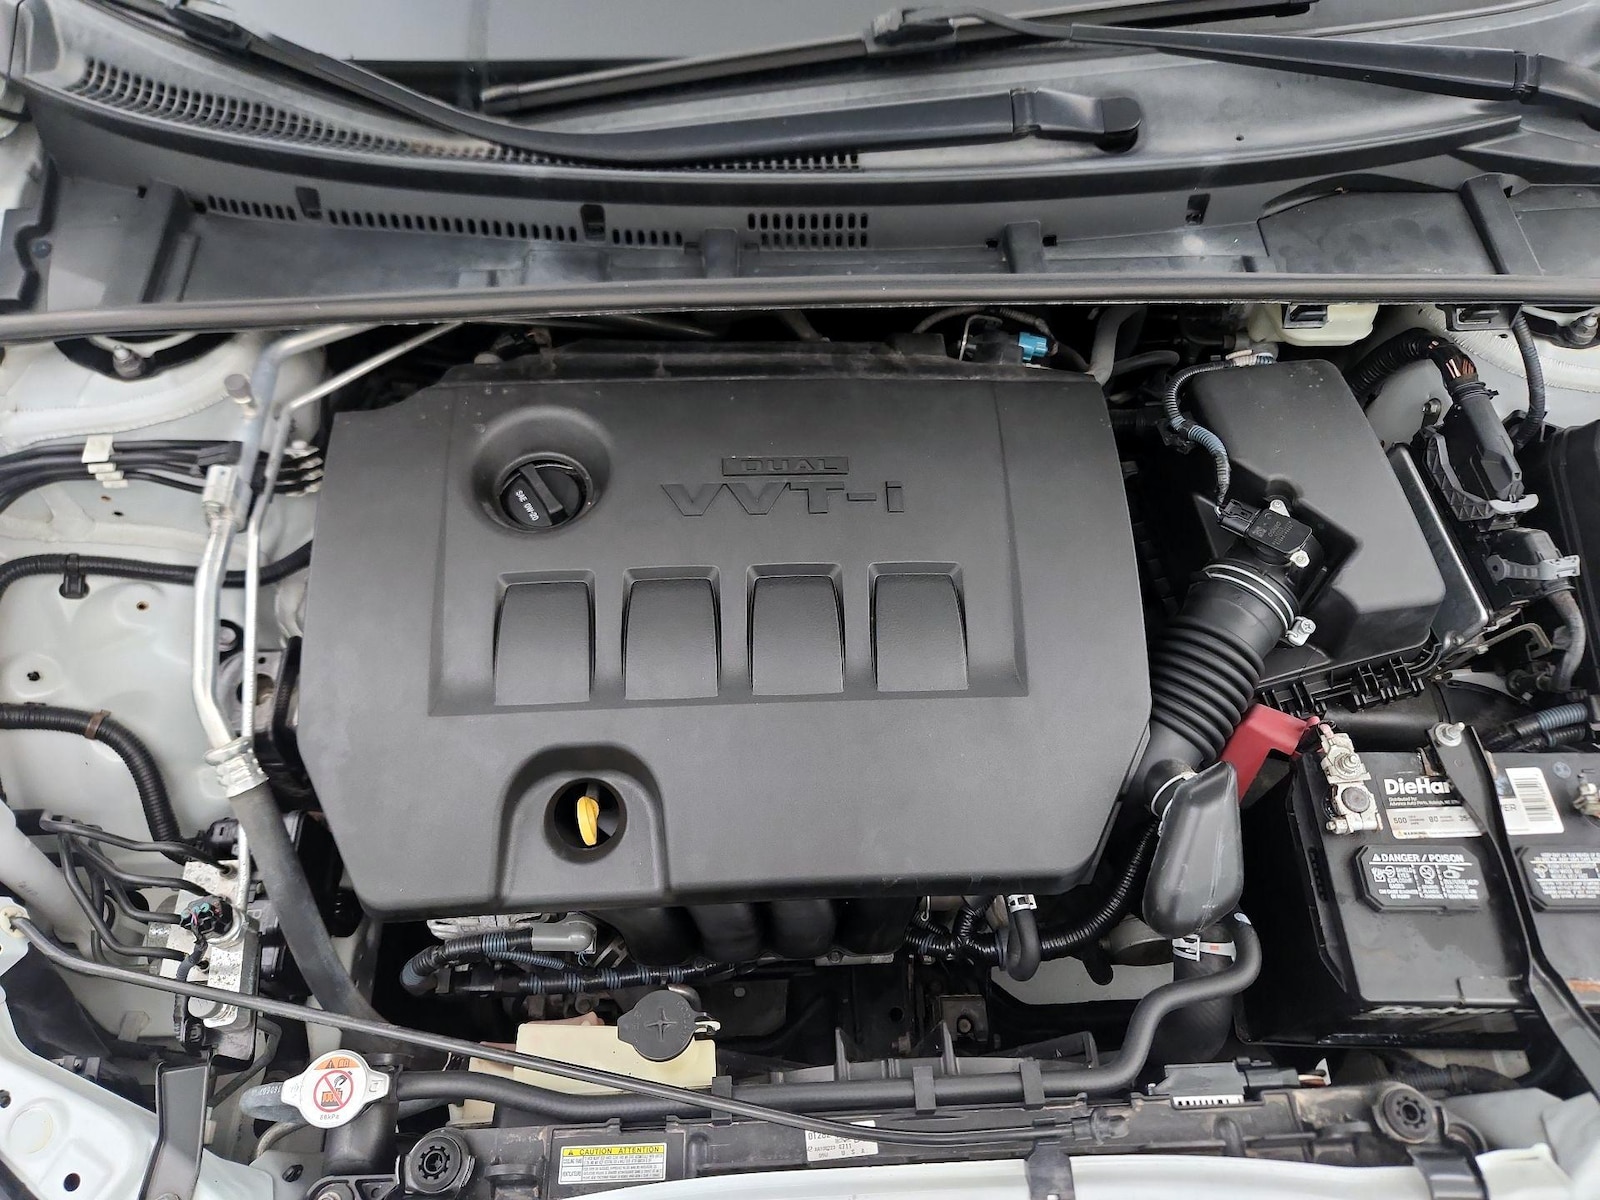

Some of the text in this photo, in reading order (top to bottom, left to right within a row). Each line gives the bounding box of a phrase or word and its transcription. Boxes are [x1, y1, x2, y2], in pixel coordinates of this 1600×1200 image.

[740, 459, 839, 471] DUAL
[515, 490, 540, 521] SAE 0W-20
[1383, 777, 1452, 795] DieHar
[1381, 853, 1420, 862] DANGER
[1428, 854, 1465, 863] POISON
[579, 1146, 660, 1156] CAUTION ATTENTION
